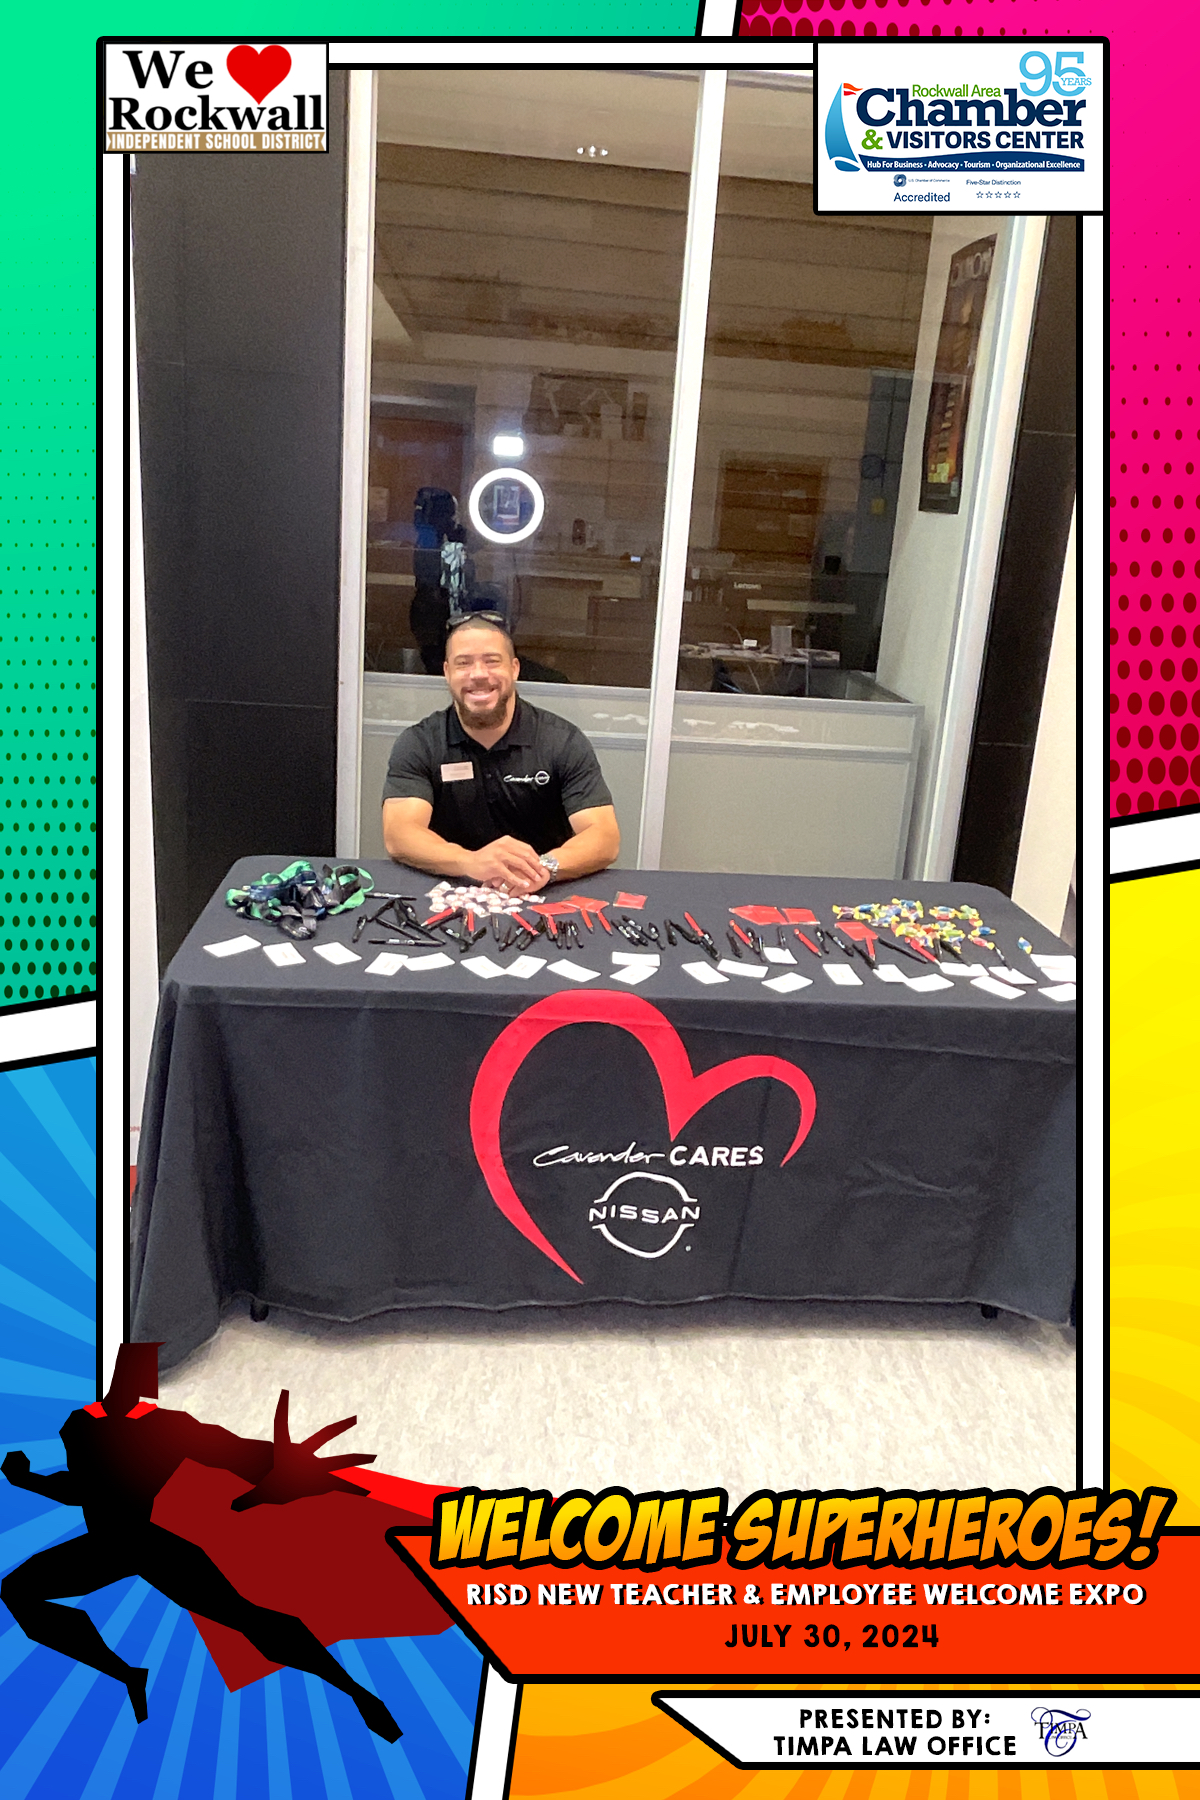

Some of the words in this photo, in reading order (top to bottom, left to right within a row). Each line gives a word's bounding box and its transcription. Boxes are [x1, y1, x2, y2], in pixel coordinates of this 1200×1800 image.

[533, 1141, 666, 1168] Cavender
[669, 1145, 764, 1167] CARES
[589, 1204, 701, 1224] NISSAN
